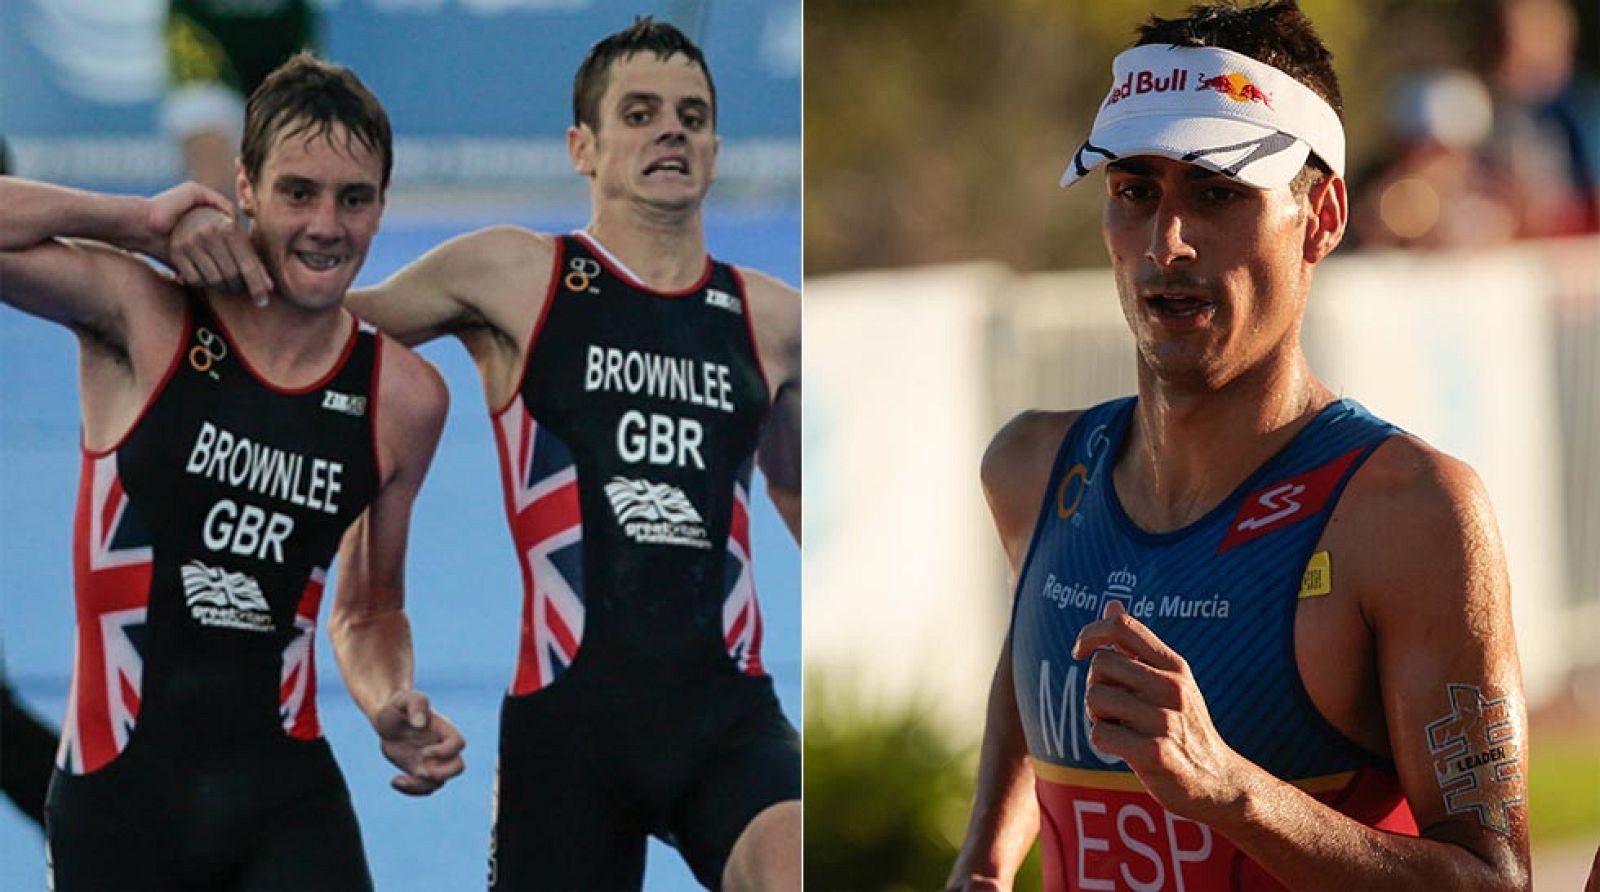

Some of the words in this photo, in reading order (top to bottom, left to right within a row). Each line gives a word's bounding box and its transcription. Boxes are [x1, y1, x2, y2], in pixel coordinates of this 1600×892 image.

[1104, 72, 1133, 109] ed
[1136, 68, 1187, 93] Bull
[585, 345, 734, 413] BROWNLEE
[186, 421, 343, 514] BROWNLEE
[617, 409, 705, 469] GBR
[203, 499, 295, 563] GBR
[1042, 573, 1098, 611] Región
[1134, 597, 1154, 617] de
[1158, 592, 1230, 619] Murcia
[1457, 747, 1506, 771] LEADER
[1072, 799, 1213, 892] ESP
